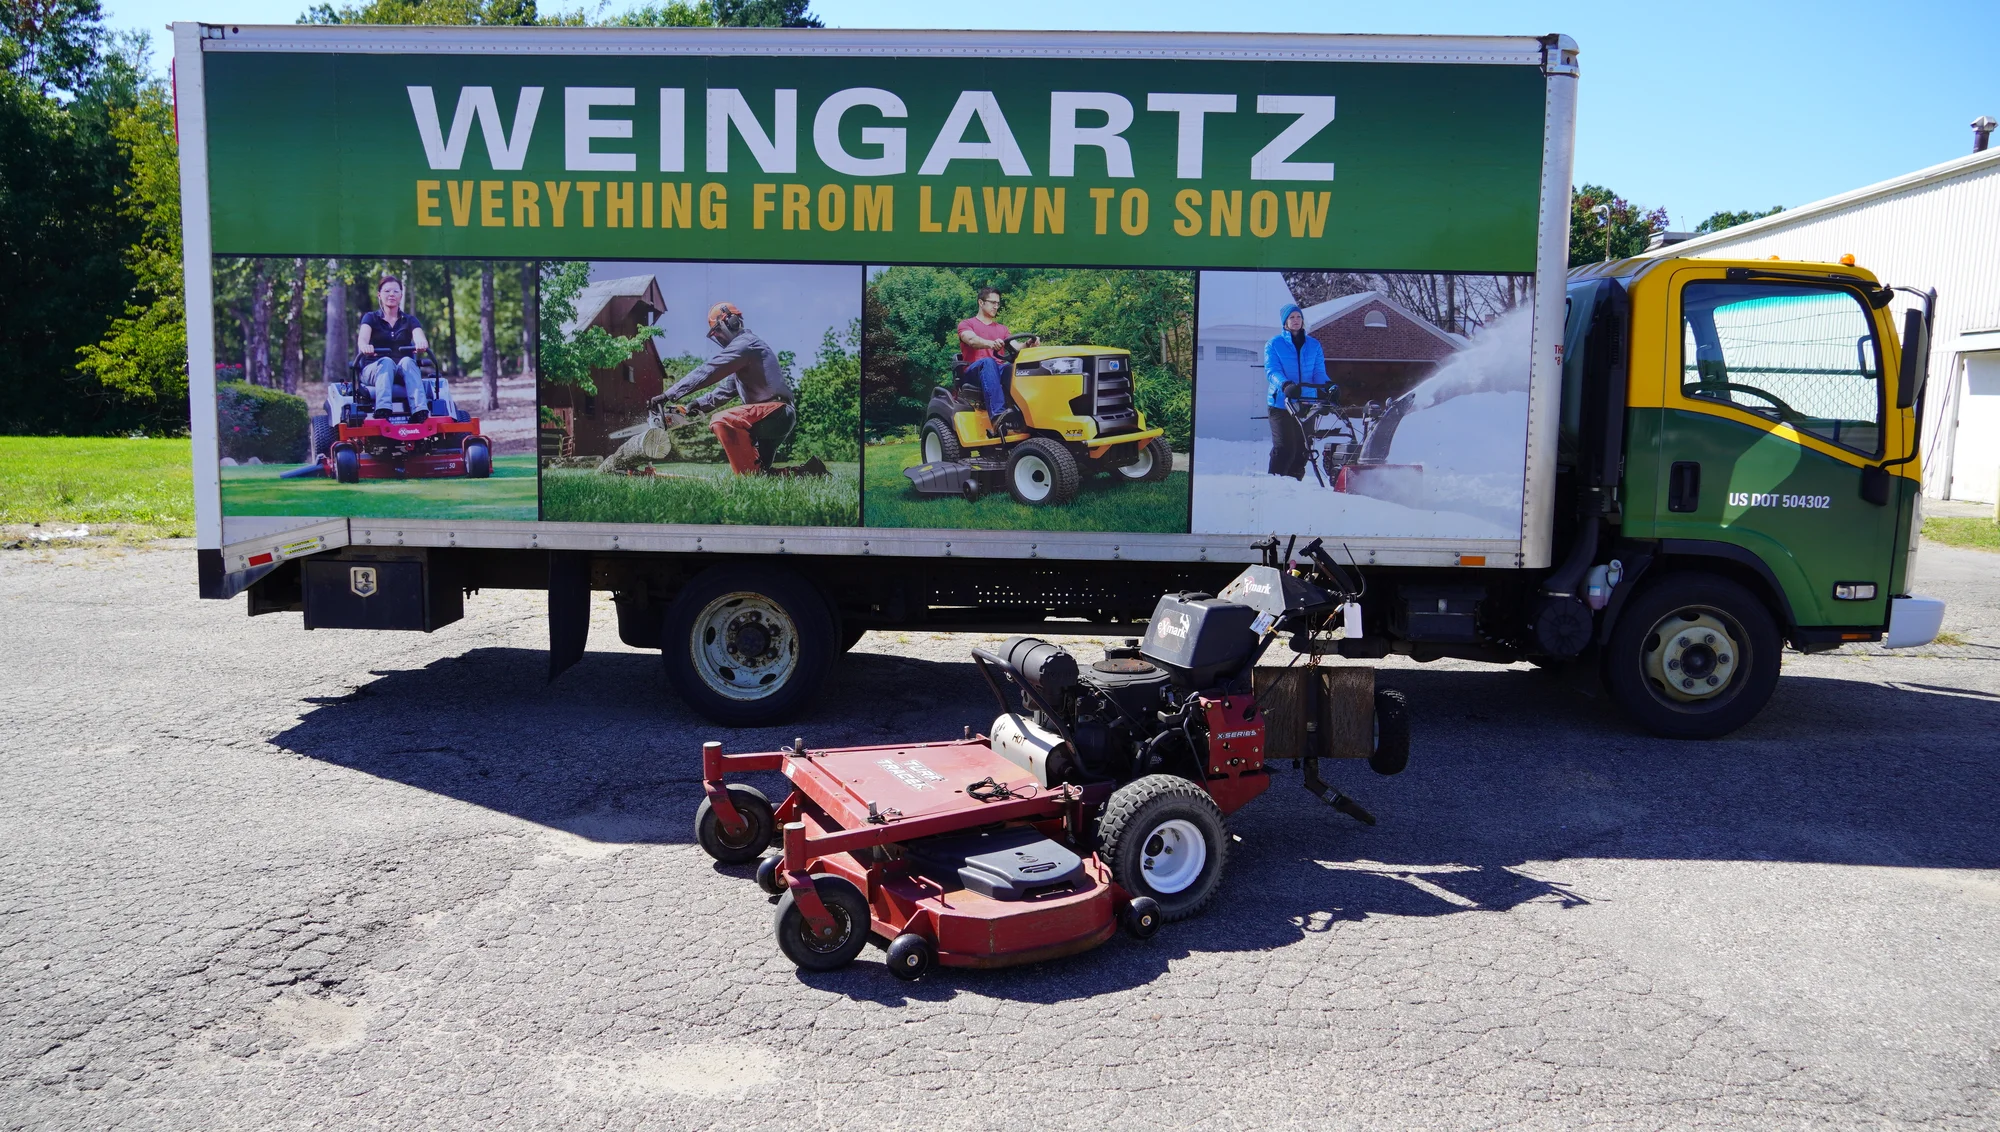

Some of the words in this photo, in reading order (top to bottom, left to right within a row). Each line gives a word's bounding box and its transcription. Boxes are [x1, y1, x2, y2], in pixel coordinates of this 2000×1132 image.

[406, 86, 1336, 181] WEINGARTZ
[416, 180, 728, 229] EVERYTHING
[753, 183, 894, 231] FROM
[919, 186, 1066, 234] LAWN
[1090, 187, 1150, 235] TO
[1174, 189, 1332, 238] SNOW
[1729, 492, 1749, 506] US
[1751, 493, 1779, 507] DOT
[1782, 494, 1830, 509] 504302
[1012, 733, 1028, 746] HOT
